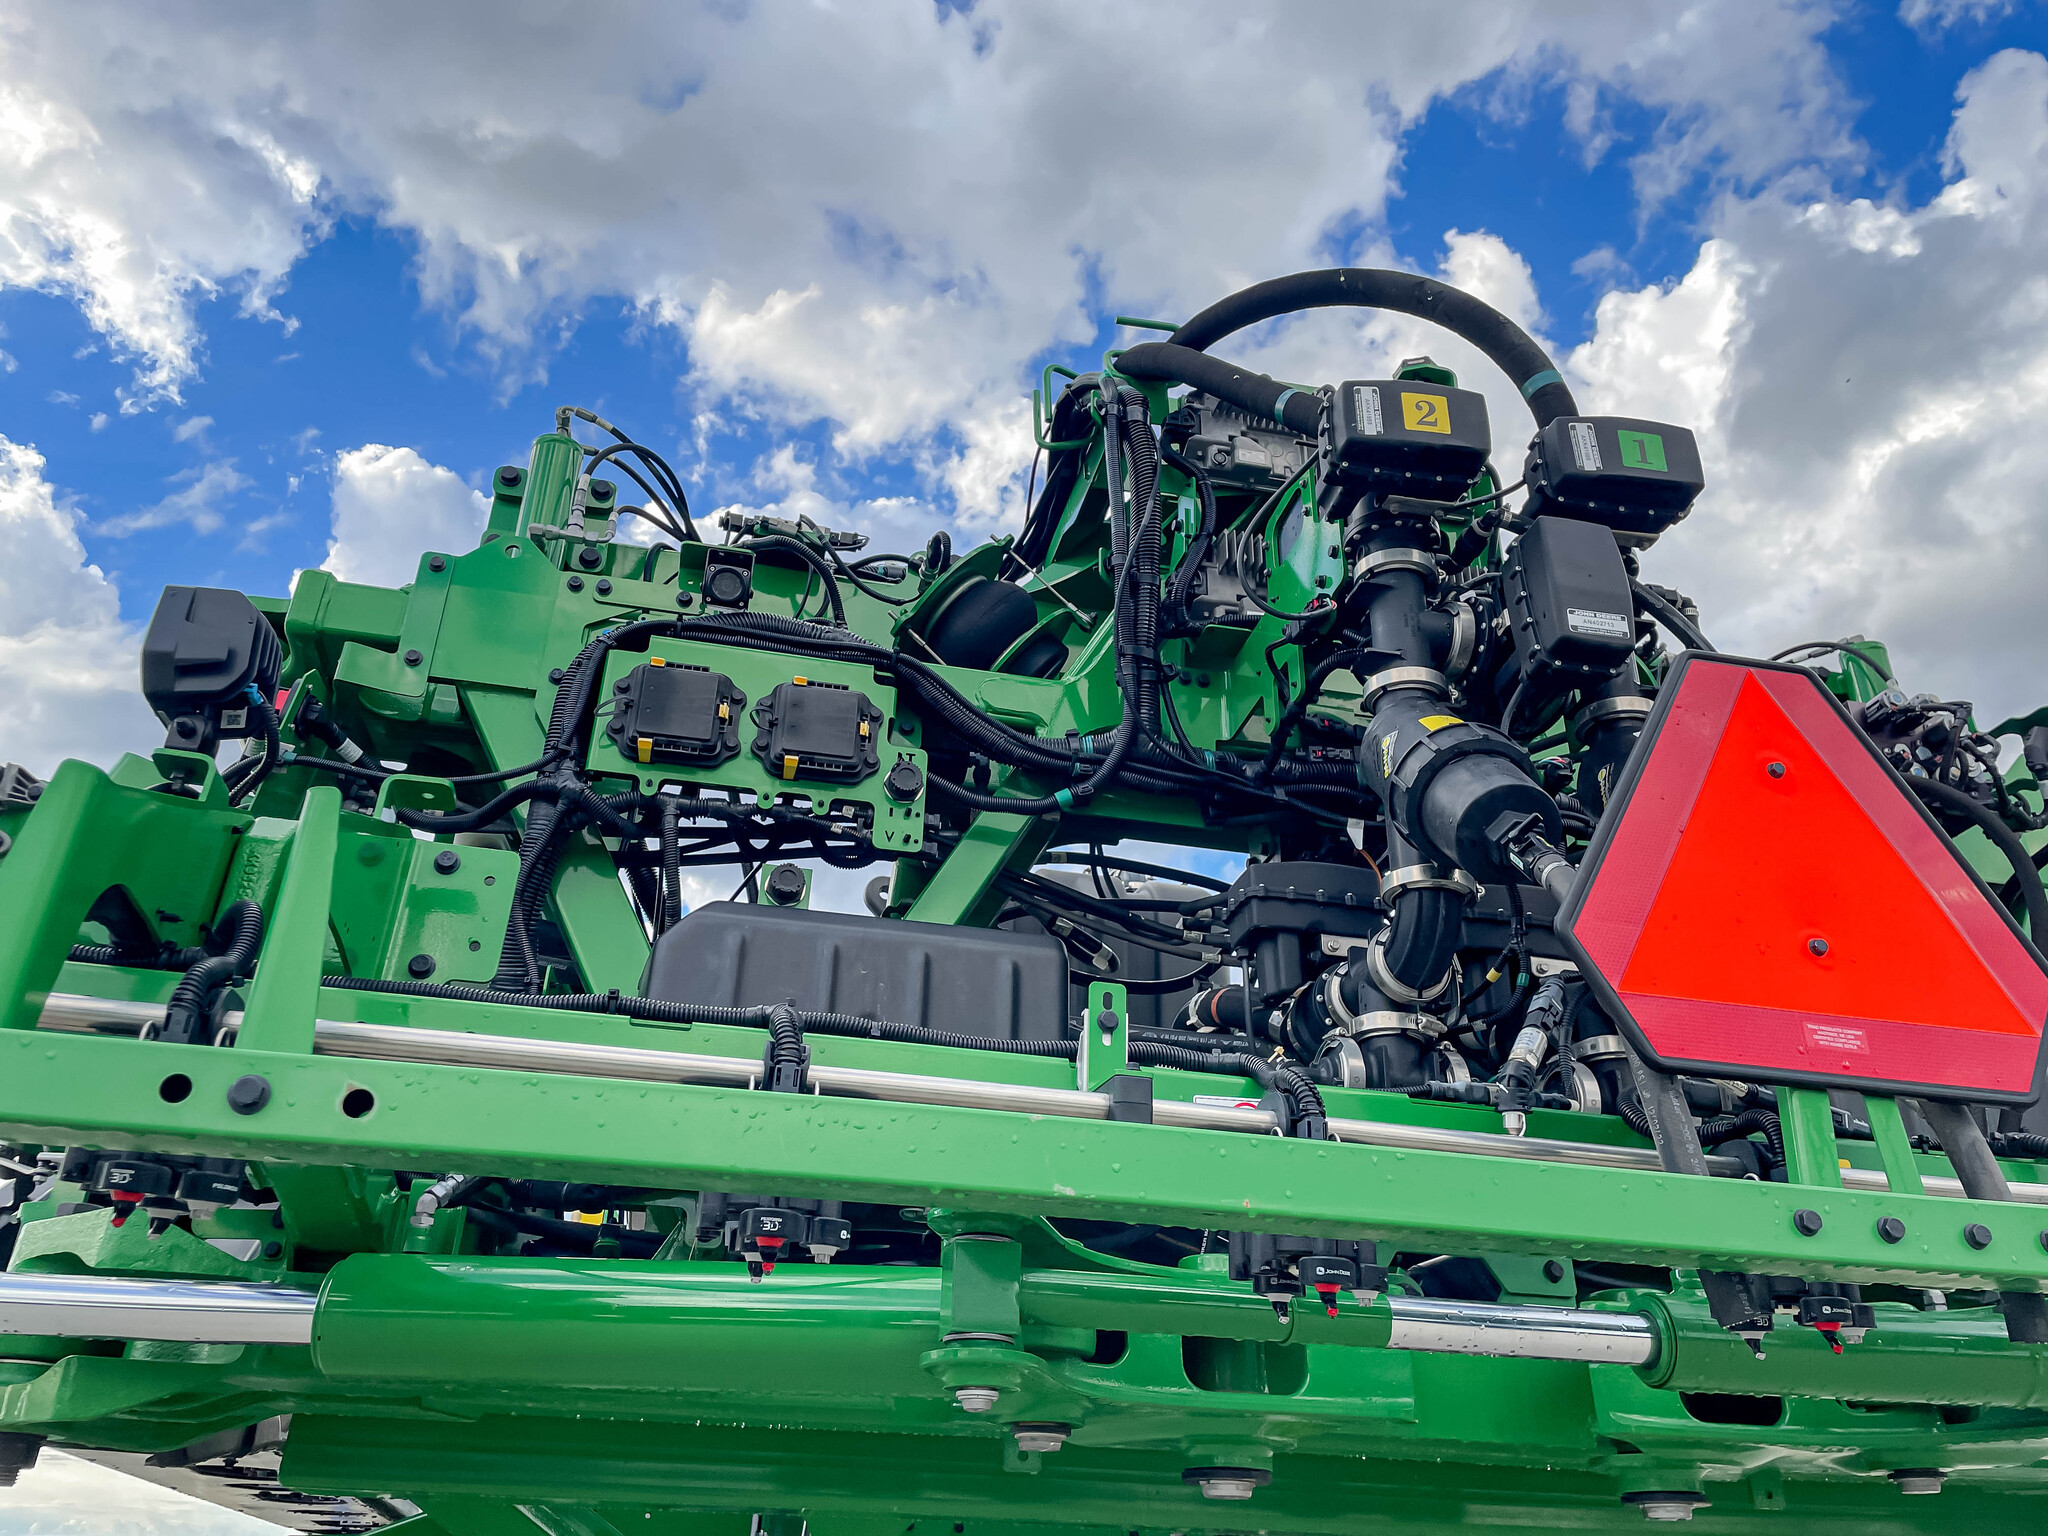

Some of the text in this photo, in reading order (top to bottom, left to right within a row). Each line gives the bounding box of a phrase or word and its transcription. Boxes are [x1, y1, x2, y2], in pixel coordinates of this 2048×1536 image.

[1374, 411, 1382, 432] DEERE
[1415, 400, 1438, 427] 2
[1588, 428, 1596, 446] JOHN
[1632, 439, 1655, 465] 1
[1596, 613, 1622, 621] DEERE
[885, 830, 895, 842] V
[1636, 1069, 1646, 1084] PSI
